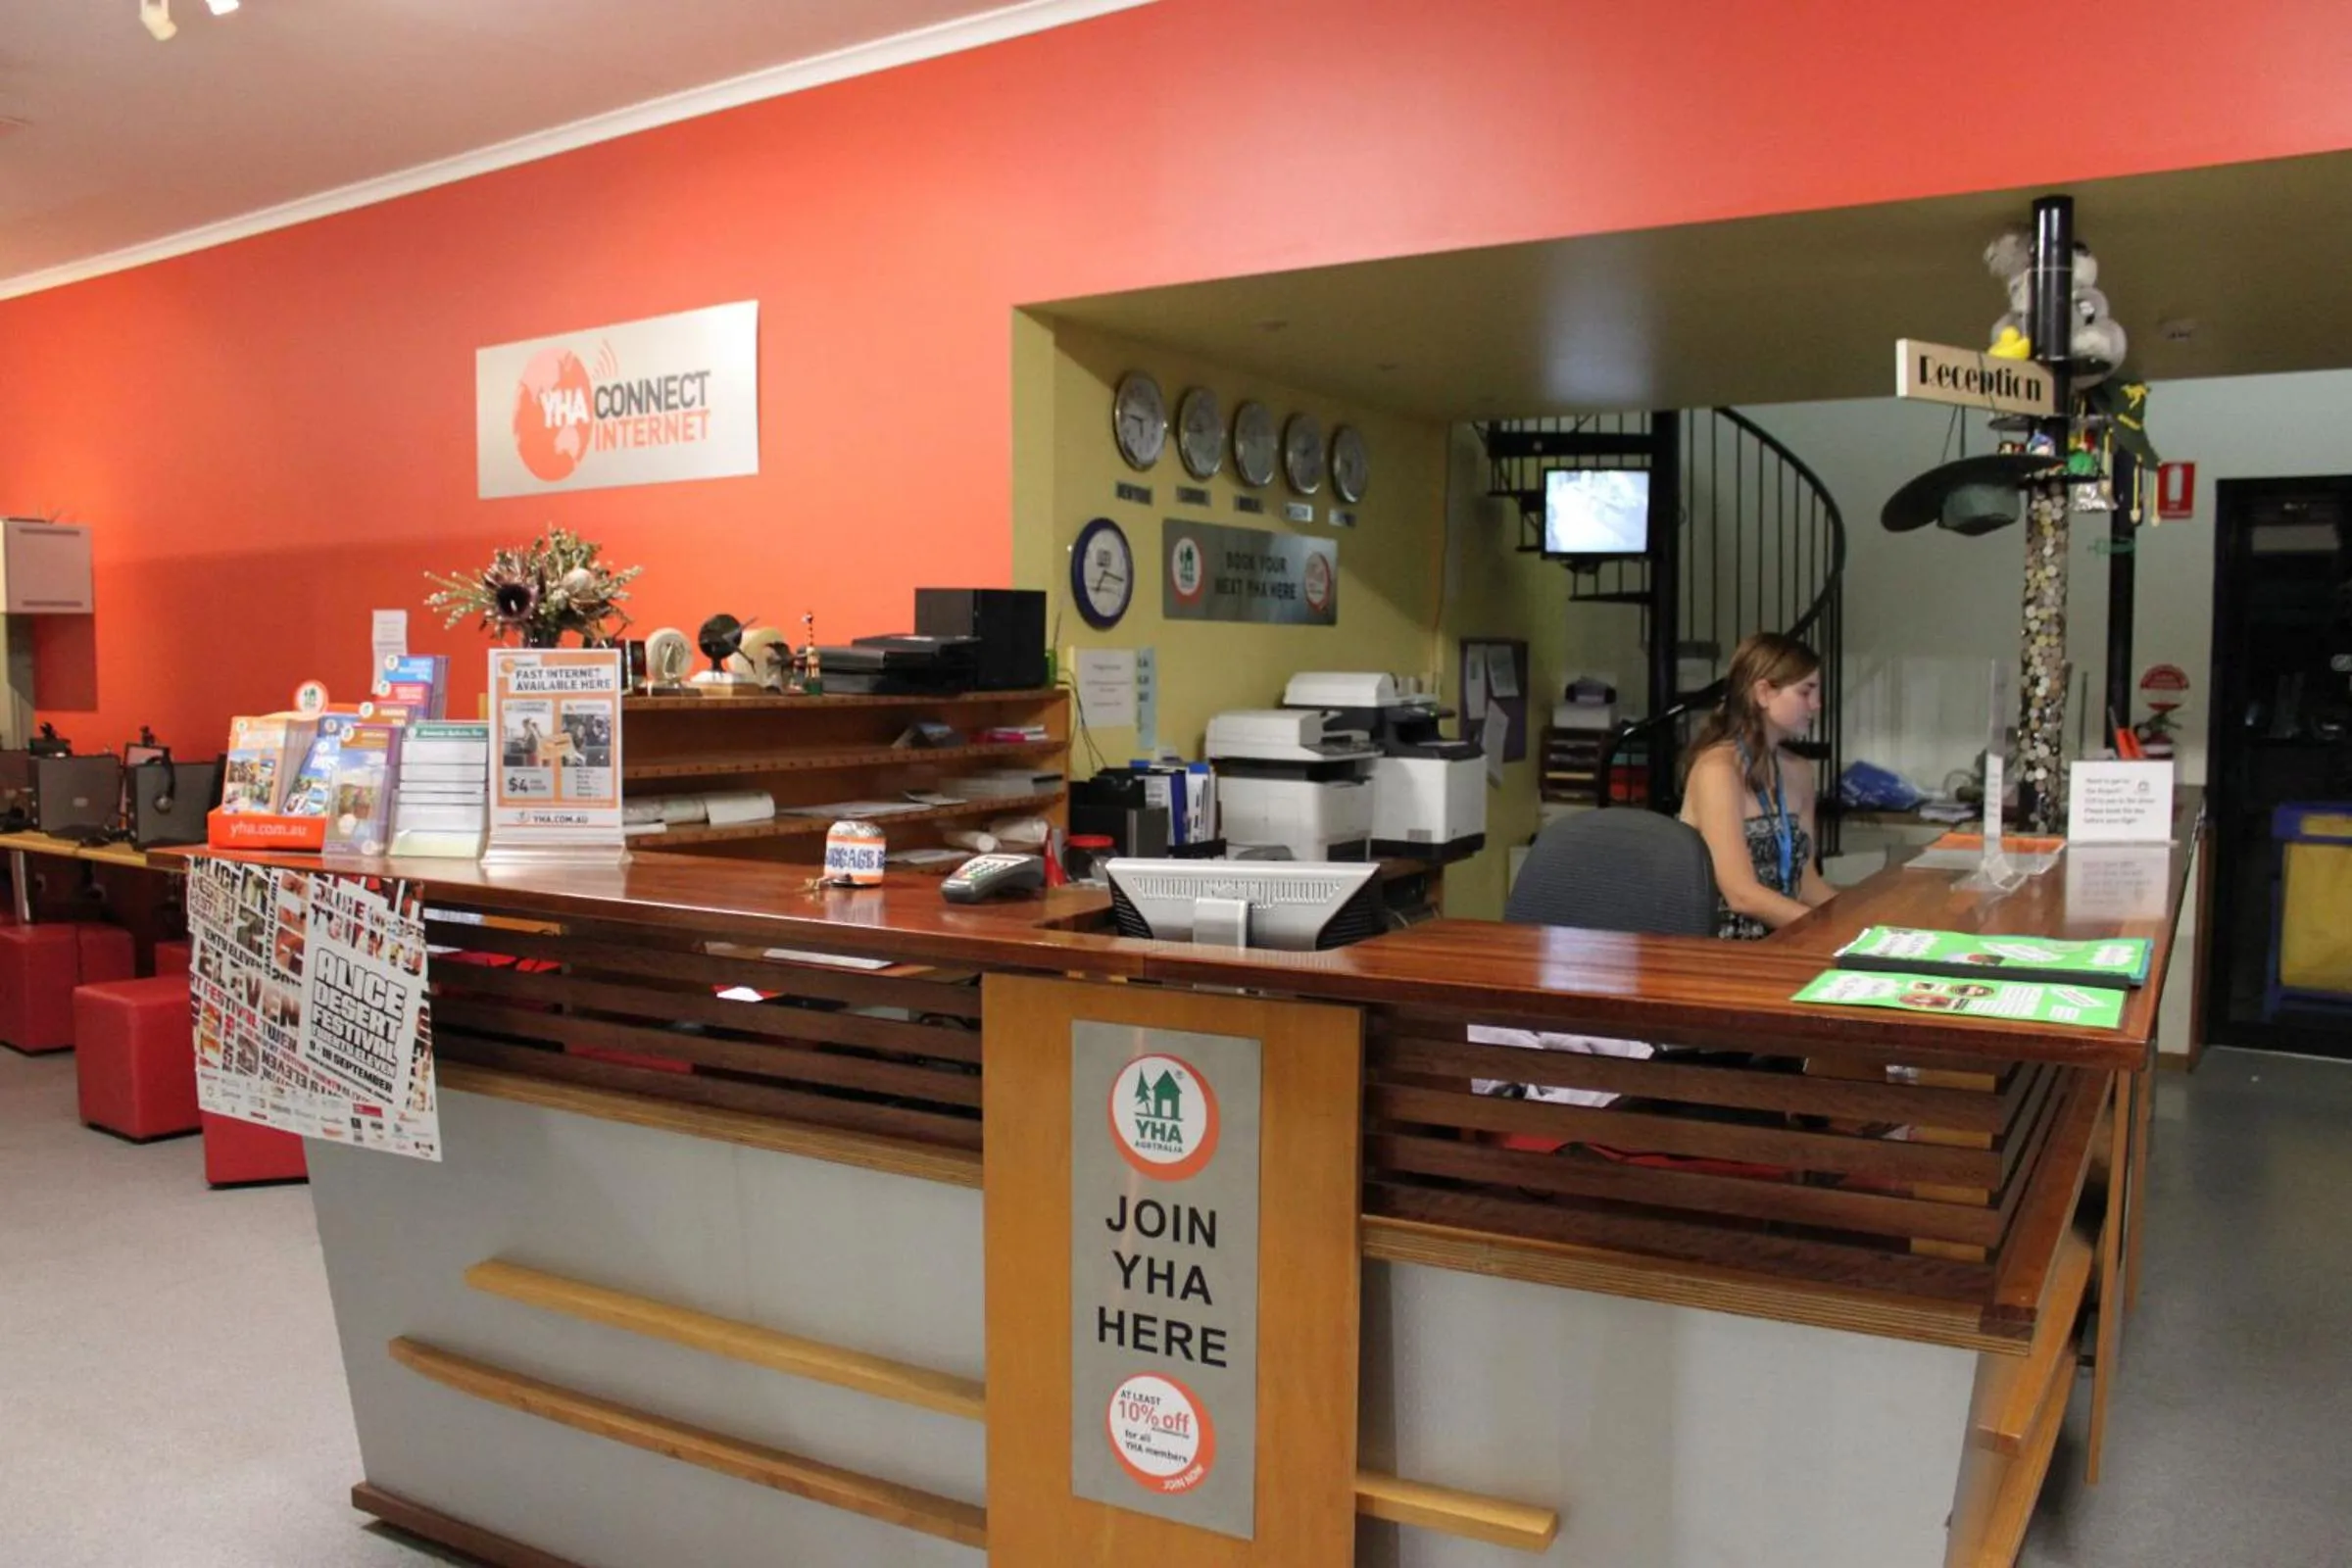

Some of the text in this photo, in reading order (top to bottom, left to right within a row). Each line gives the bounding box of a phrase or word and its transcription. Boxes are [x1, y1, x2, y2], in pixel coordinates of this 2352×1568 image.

[1918, 355, 2043, 403] Reception
[539, 370, 710, 429] YHA CONNECT
[594, 409, 710, 452] INTERNET
[1270, 581, 1297, 601] HERE
[515, 667, 600, 679] FAST INTERNET
[515, 678, 612, 691] AVAILABLE HERE
[508, 776, 528, 793] $4
[230, 820, 308, 838] yha.com.au
[826, 848, 875, 869] UGGAGE
[315, 947, 408, 1020] ALICE
[313, 978, 404, 1042] DESERT
[311, 1004, 398, 1066] FESTIVAL
[333, 1054, 393, 1094] SEPTEMBER
[1135, 1118, 1183, 1144] YHA
[1135, 1140, 1183, 1153] AUSTRALIA
[1104, 1195, 1216, 1249] JOIN
[1112, 1250, 1213, 1306] YHA
[1098, 1305, 1227, 1368] HERE
[1120, 1389, 1161, 1405] AT LEAST
[1118, 1399, 1191, 1433] 10% off
[1125, 1429, 1138, 1440] for
[1140, 1433, 1152, 1443] all
[1125, 1441, 1189, 1463] YHA members
[1162, 1463, 1204, 1491] JOIN NOW
